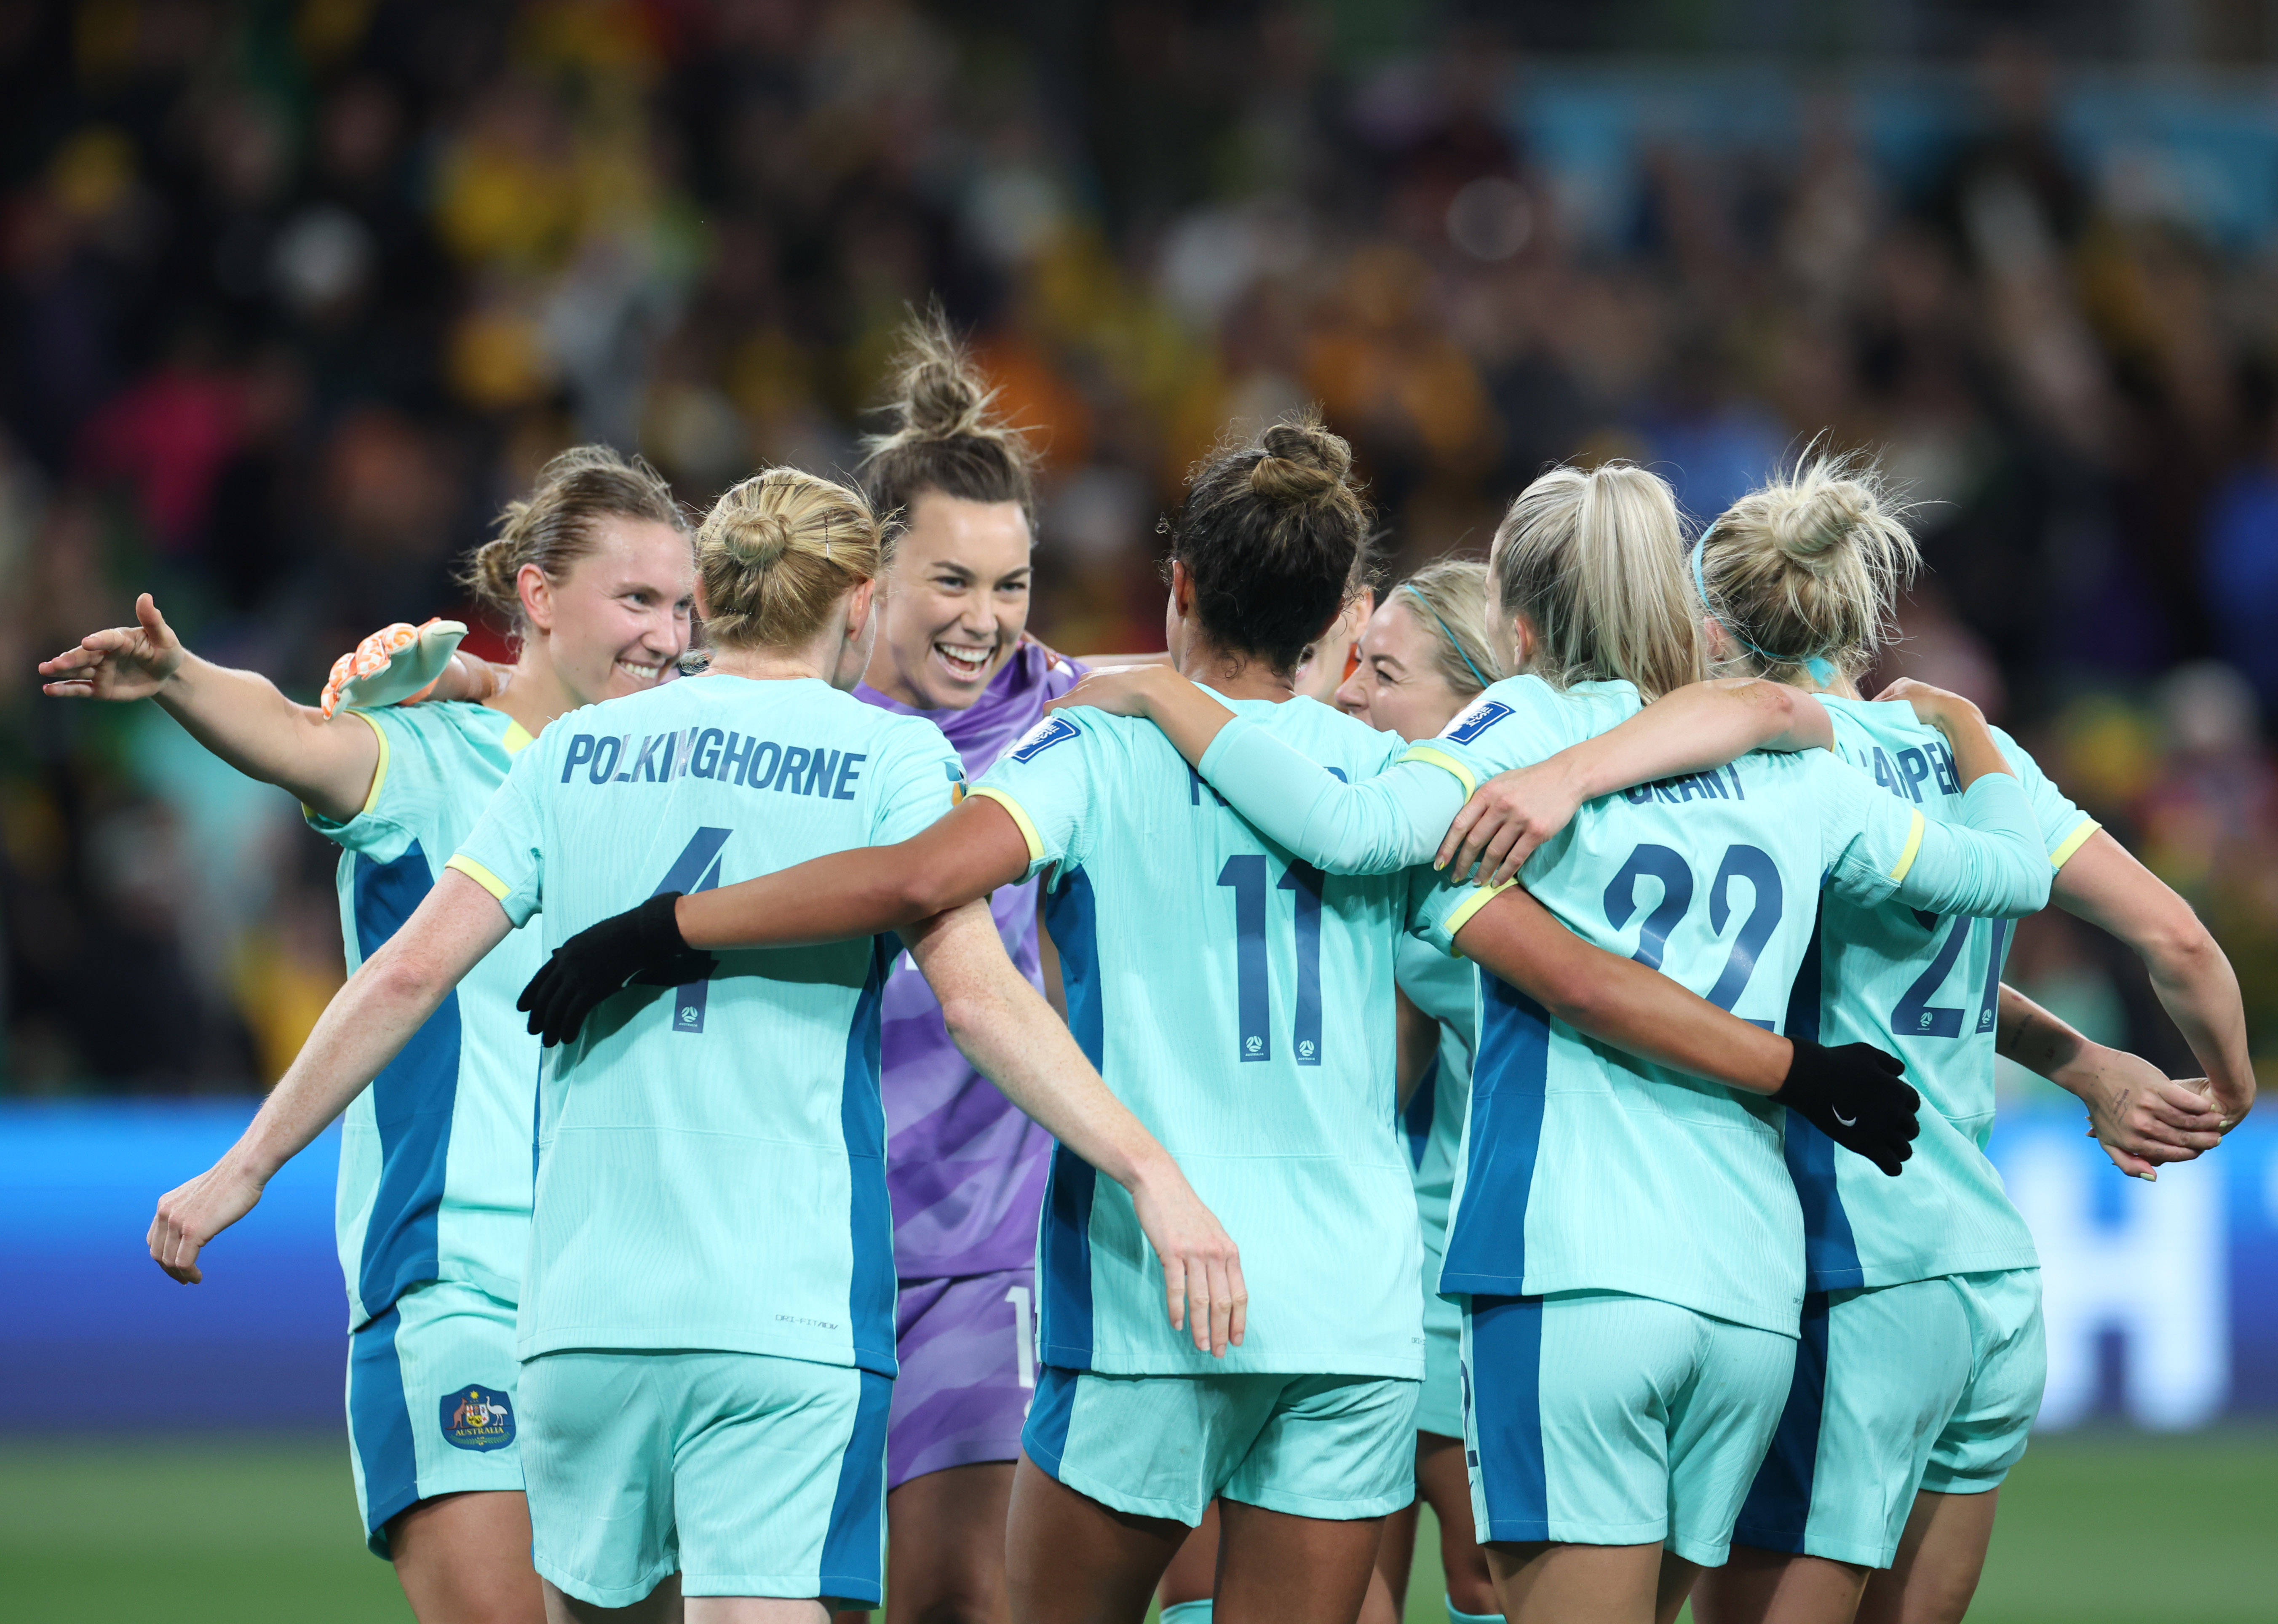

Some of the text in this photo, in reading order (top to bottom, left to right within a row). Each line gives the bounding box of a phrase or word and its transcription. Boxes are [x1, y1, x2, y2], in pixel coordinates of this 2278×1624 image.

[561, 727, 866, 801] POLKINGHORNE
[1216, 854, 1326, 1066] 11
[455, 1426, 505, 1436] AUSTRALIA
